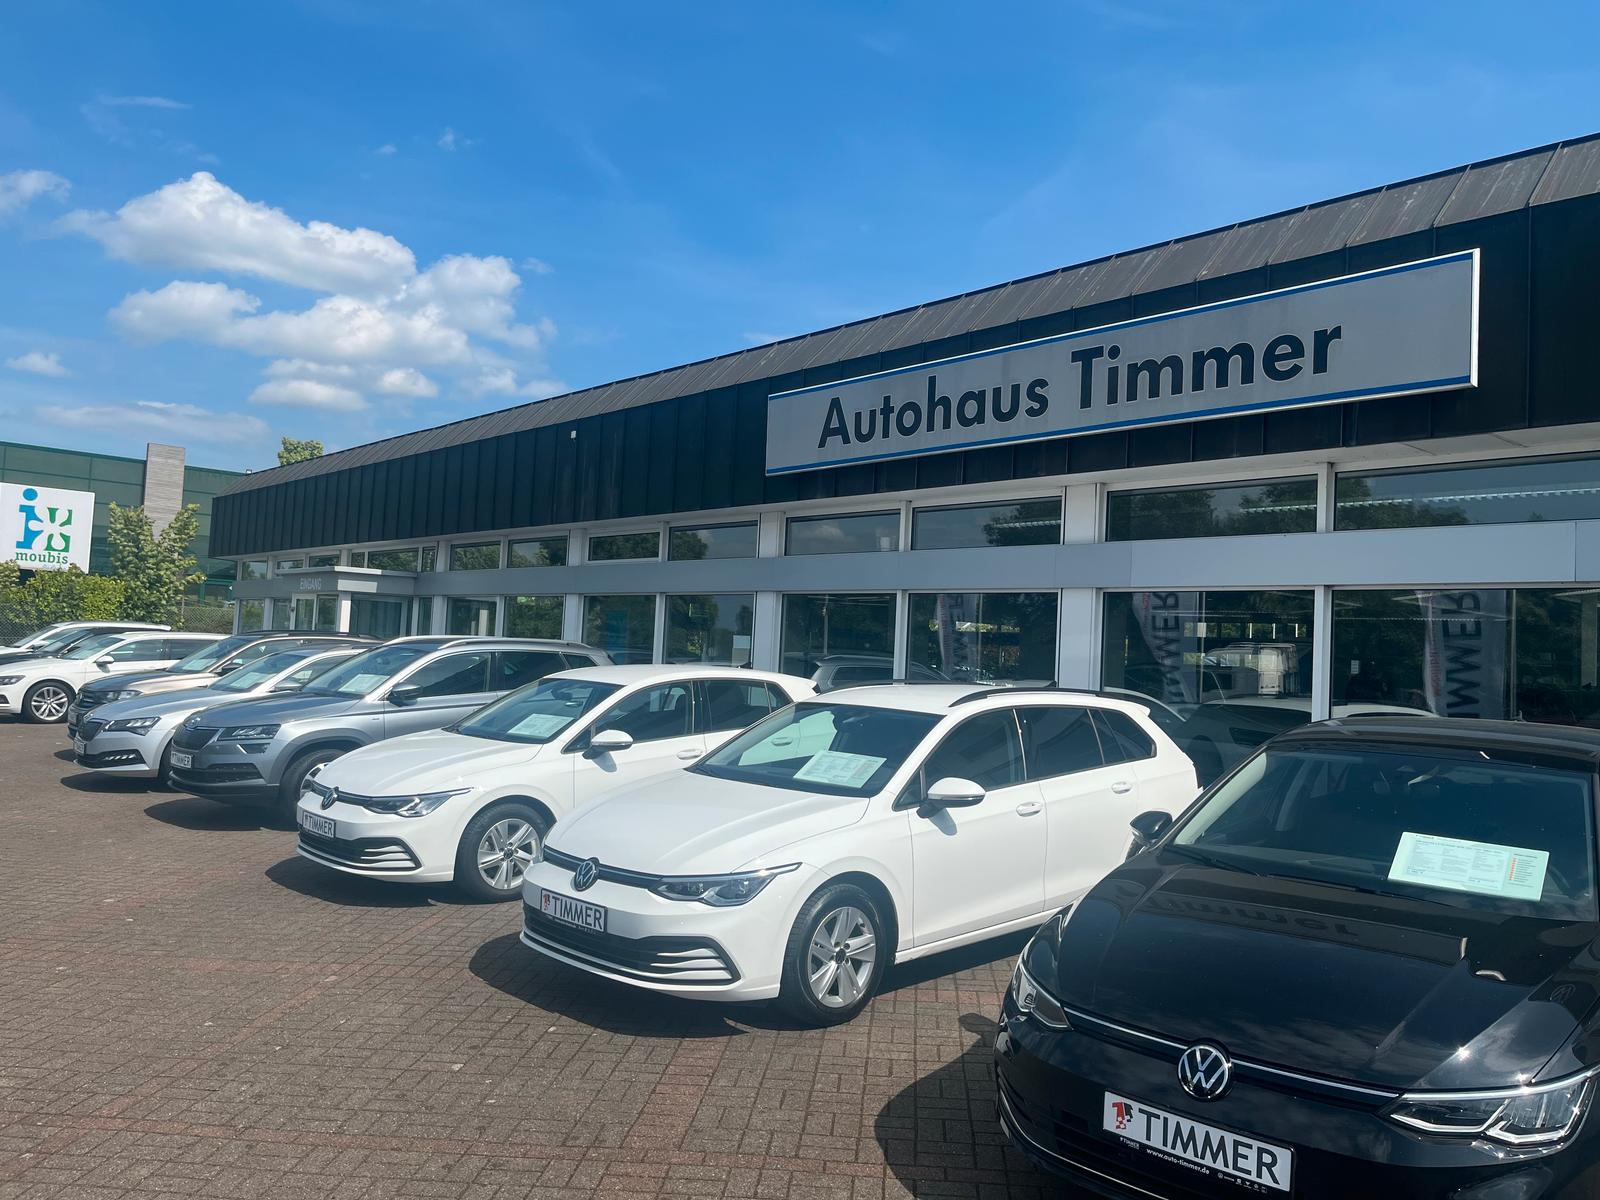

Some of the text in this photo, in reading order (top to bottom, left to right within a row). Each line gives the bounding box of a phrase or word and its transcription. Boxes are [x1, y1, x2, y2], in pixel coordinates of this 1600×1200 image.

[818, 325, 1342, 449] Autohaus Timmer
[15, 551, 69, 565] moubis
[308, 815, 333, 836] TIMMER
[552, 895, 602, 930] TIMMER
[1178, 1045, 1229, 1098] VW
[1138, 1107, 1281, 1186] TIMMER
[1146, 1148, 1210, 1175] www.auto-timmer.de
